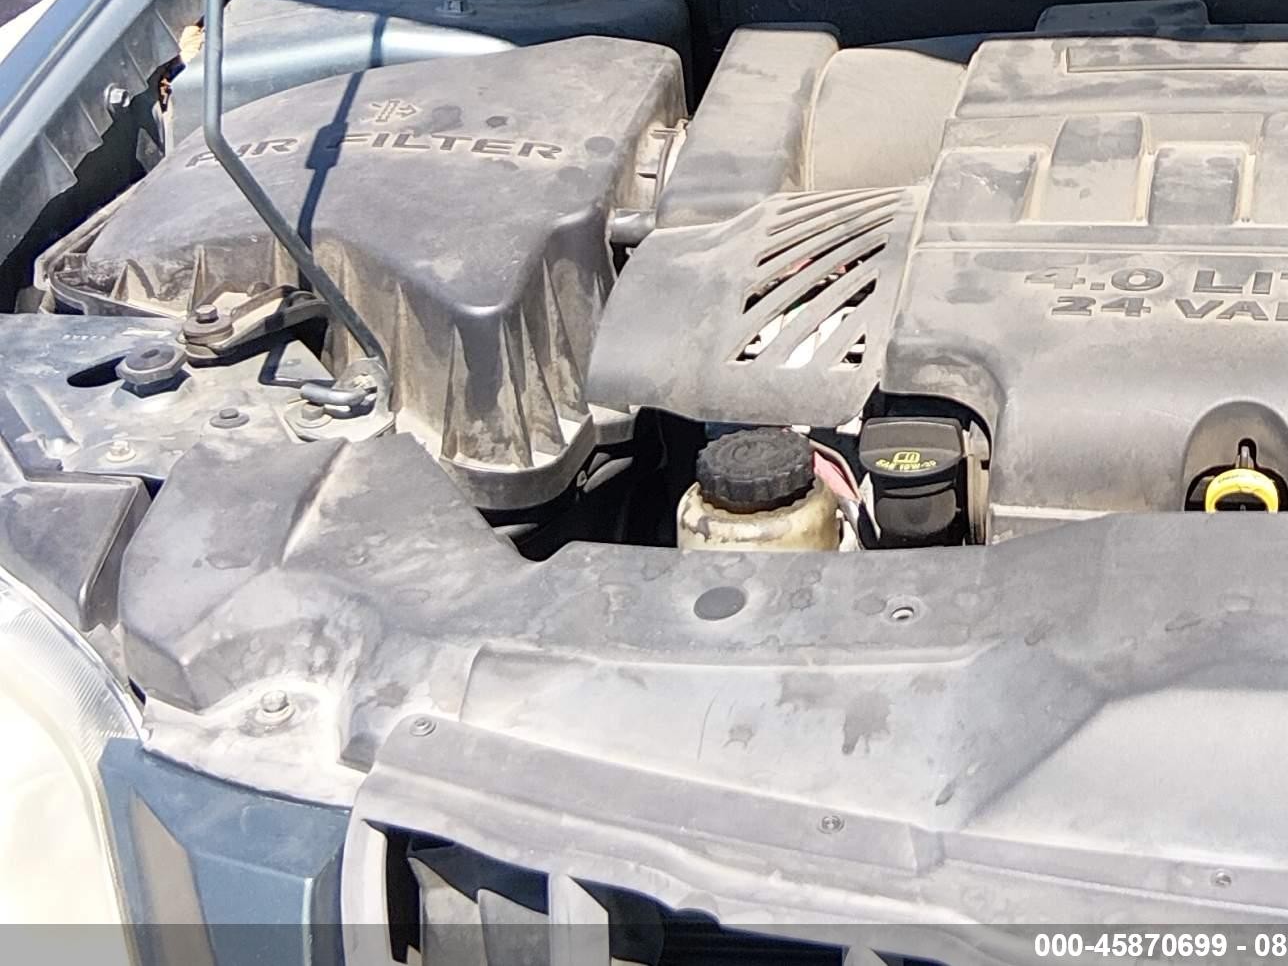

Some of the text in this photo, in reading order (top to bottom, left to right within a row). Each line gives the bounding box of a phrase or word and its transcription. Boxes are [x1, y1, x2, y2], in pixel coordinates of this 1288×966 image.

[326, 132, 563, 160] FILTER
[1024, 266, 1164, 292] 4.0
[1051, 296, 1151, 317] 24
